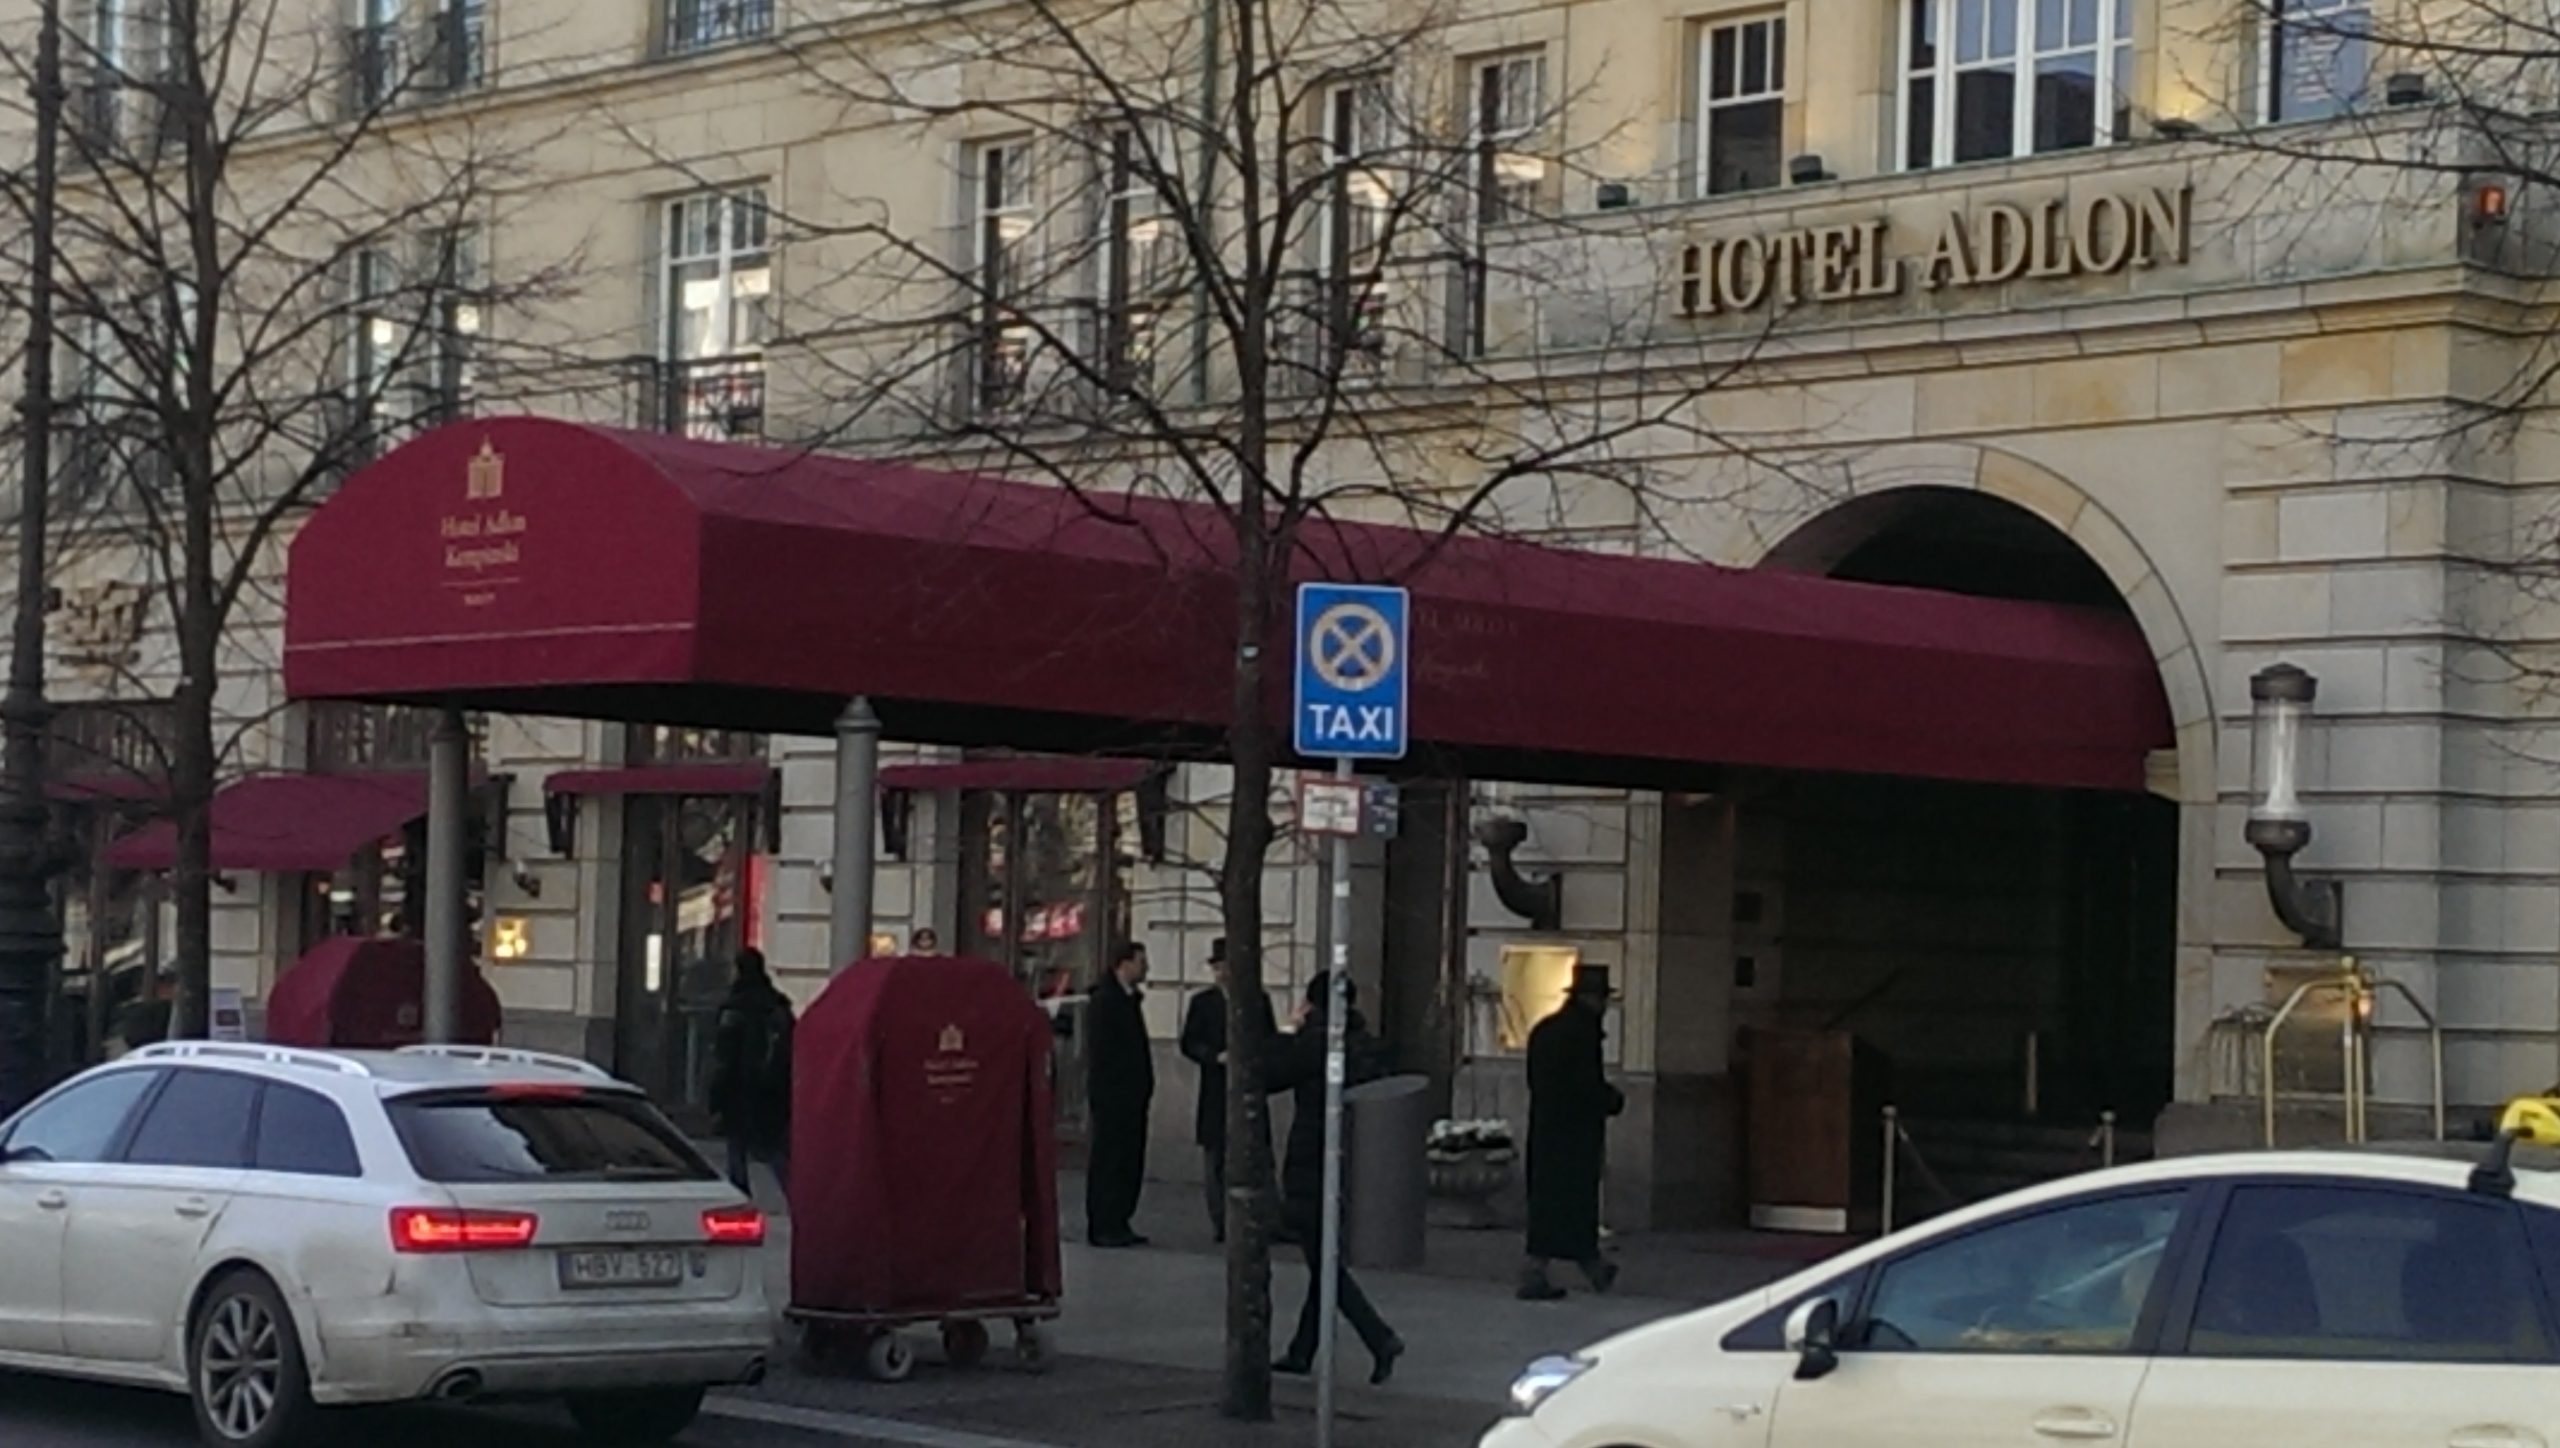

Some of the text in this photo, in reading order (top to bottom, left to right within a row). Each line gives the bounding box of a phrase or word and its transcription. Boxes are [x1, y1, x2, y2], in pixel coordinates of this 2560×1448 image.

[1673, 187, 2193, 318] HOTEL ADLON
[1308, 703, 1394, 741] TAXI
